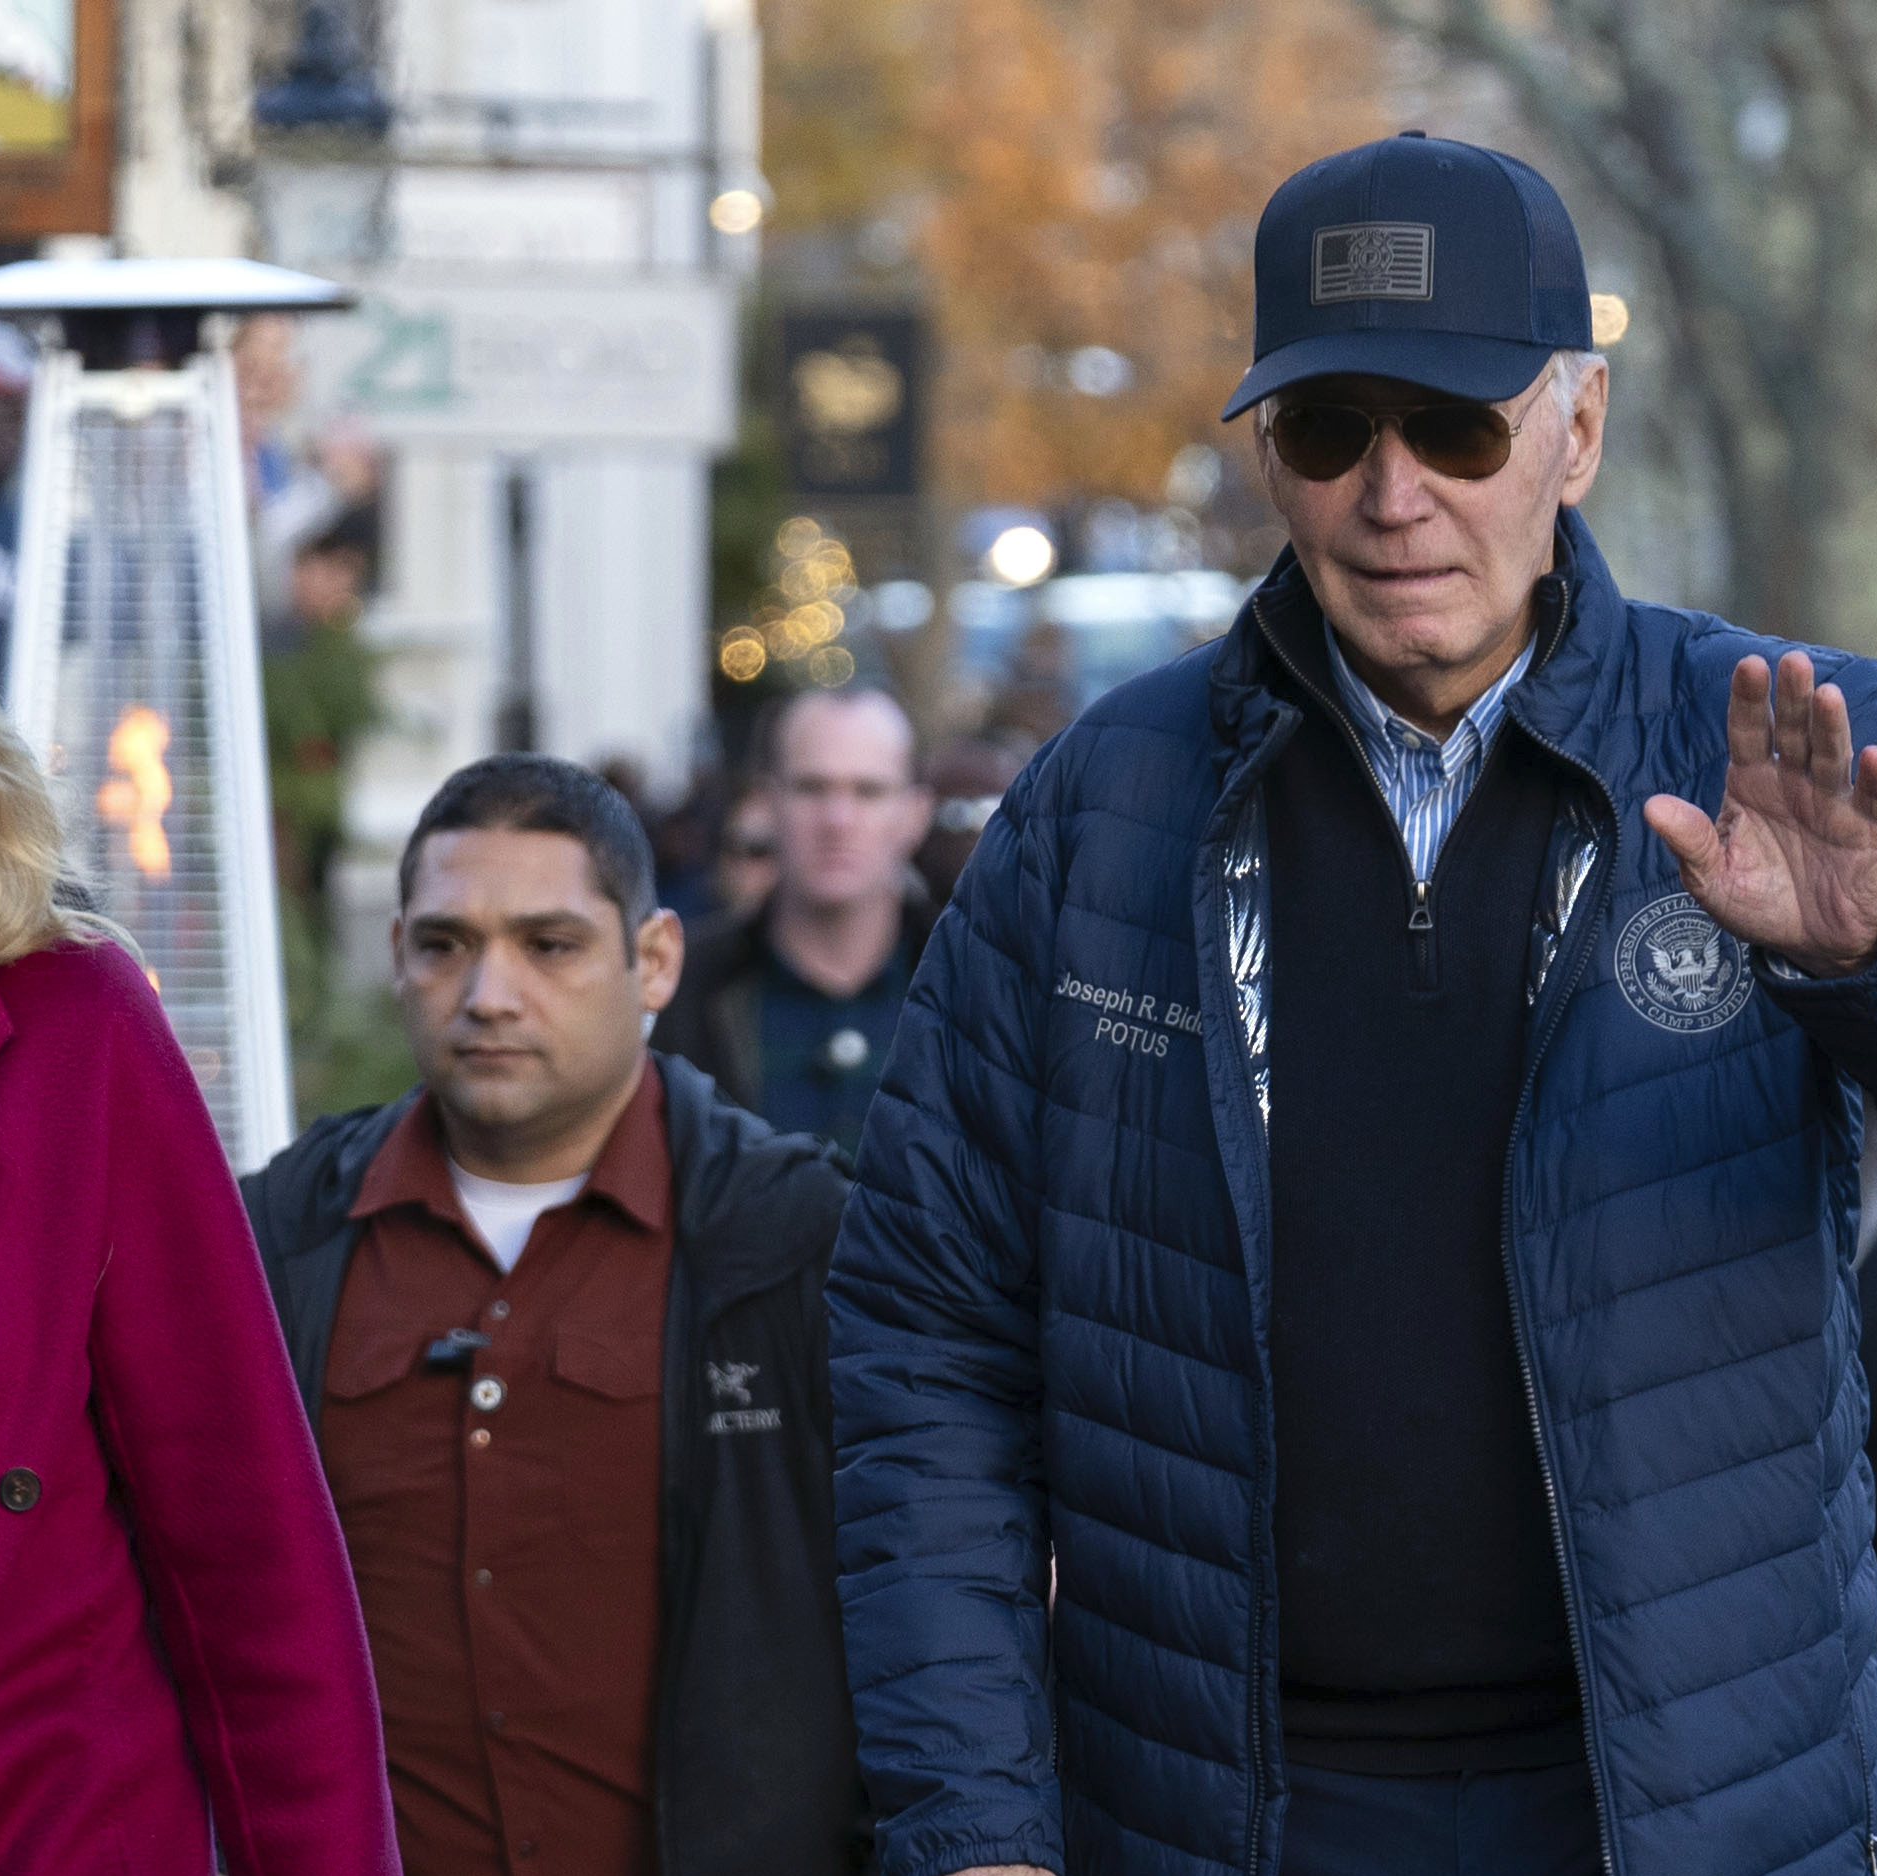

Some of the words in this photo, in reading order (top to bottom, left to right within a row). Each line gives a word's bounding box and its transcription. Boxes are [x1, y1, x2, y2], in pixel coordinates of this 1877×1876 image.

[1620, 898, 1700, 982] PRESIDENTIAL
[1057, 972, 1134, 1014] Joseph
[1138, 995, 1158, 1022] R.
[1647, 1006, 1694, 1029] CAMP
[1699, 991, 1744, 1027] DAVID
[1094, 1017, 1169, 1057] POTUS
